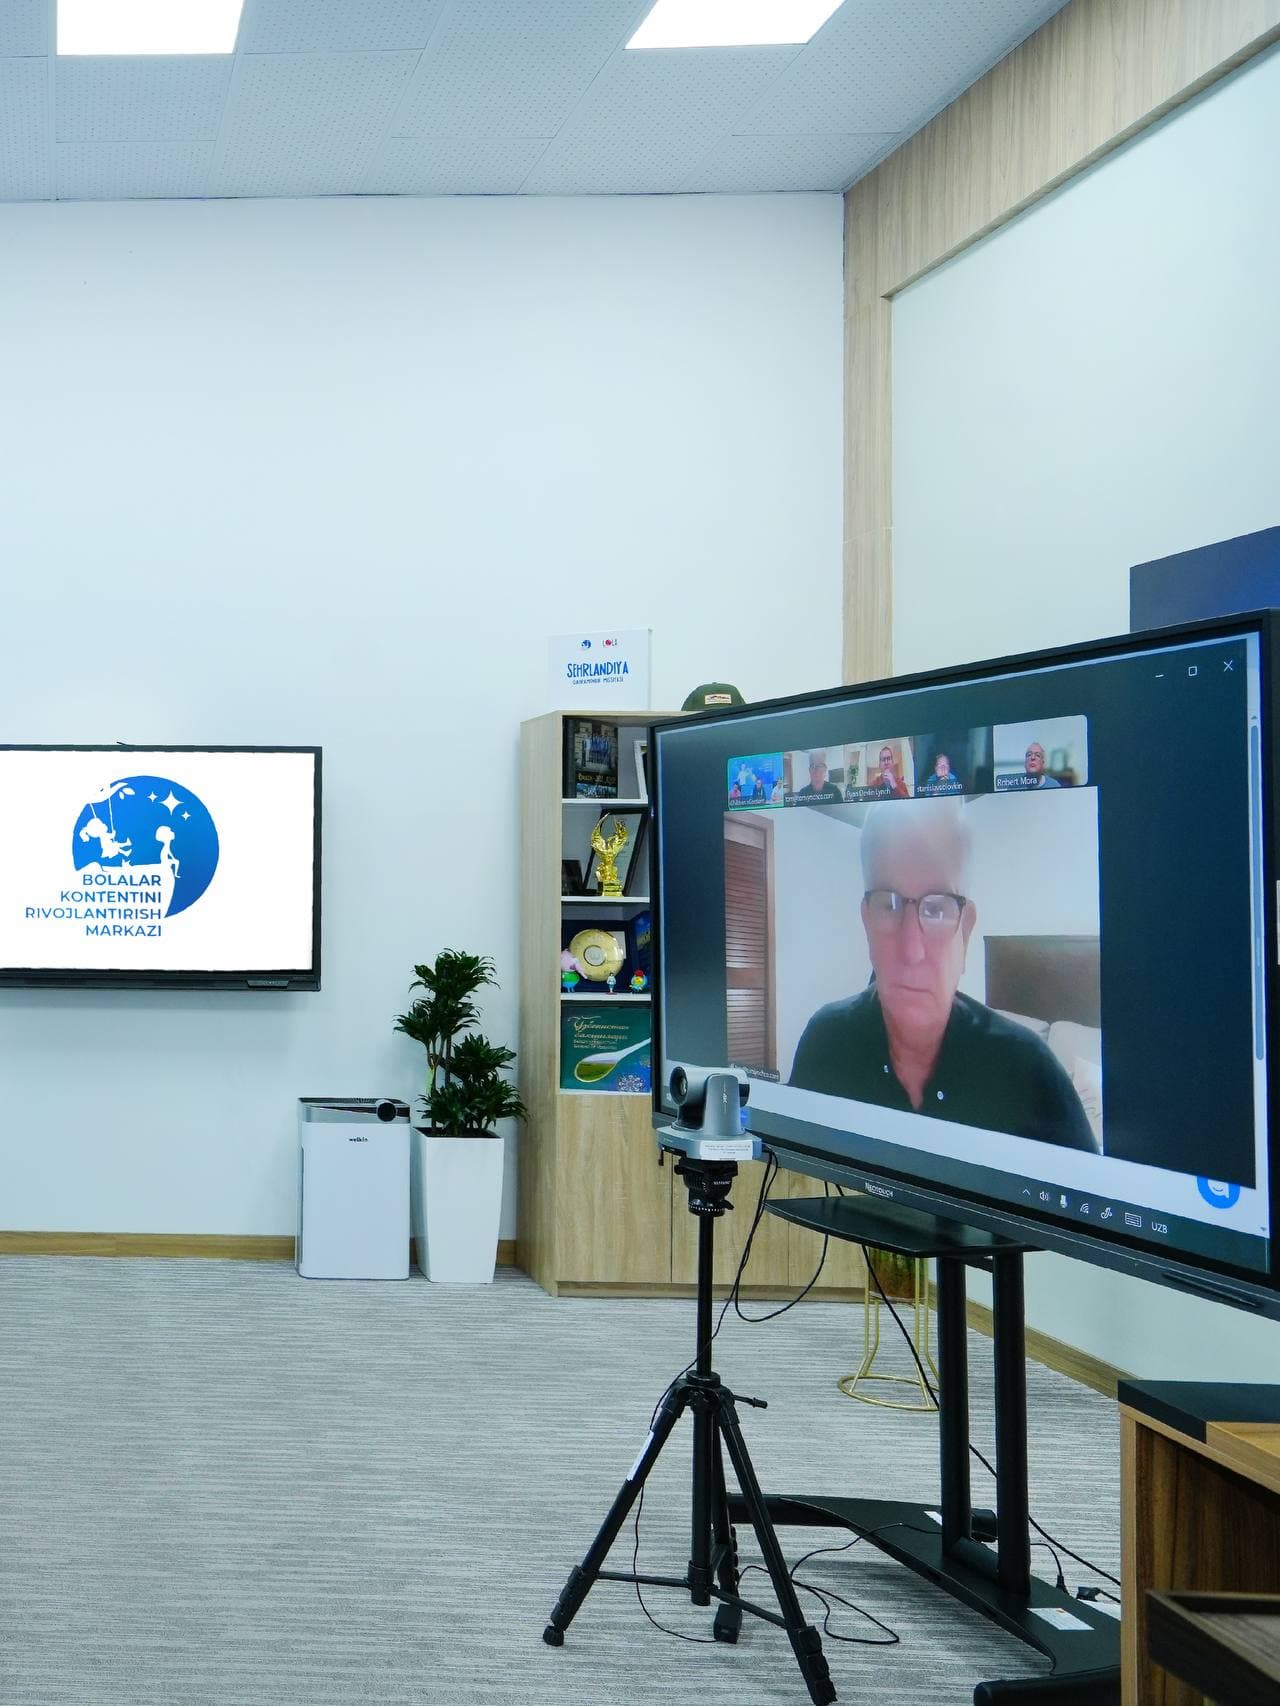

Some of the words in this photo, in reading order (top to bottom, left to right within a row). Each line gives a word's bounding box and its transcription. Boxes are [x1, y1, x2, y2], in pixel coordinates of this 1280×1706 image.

[567, 661, 629, 677] SEHRLANDIYA
[997, 778, 1019, 786] Robert
[1020, 777, 1038, 785] Mora
[82, 874, 162, 887] BOLALAR
[60, 890, 162, 903] KONTENTINI
[25, 907, 162, 920] RIVOJLANTIRISH
[86, 925, 162, 937] MARKAZI
[1151, 1221, 1168, 1234] UZB
